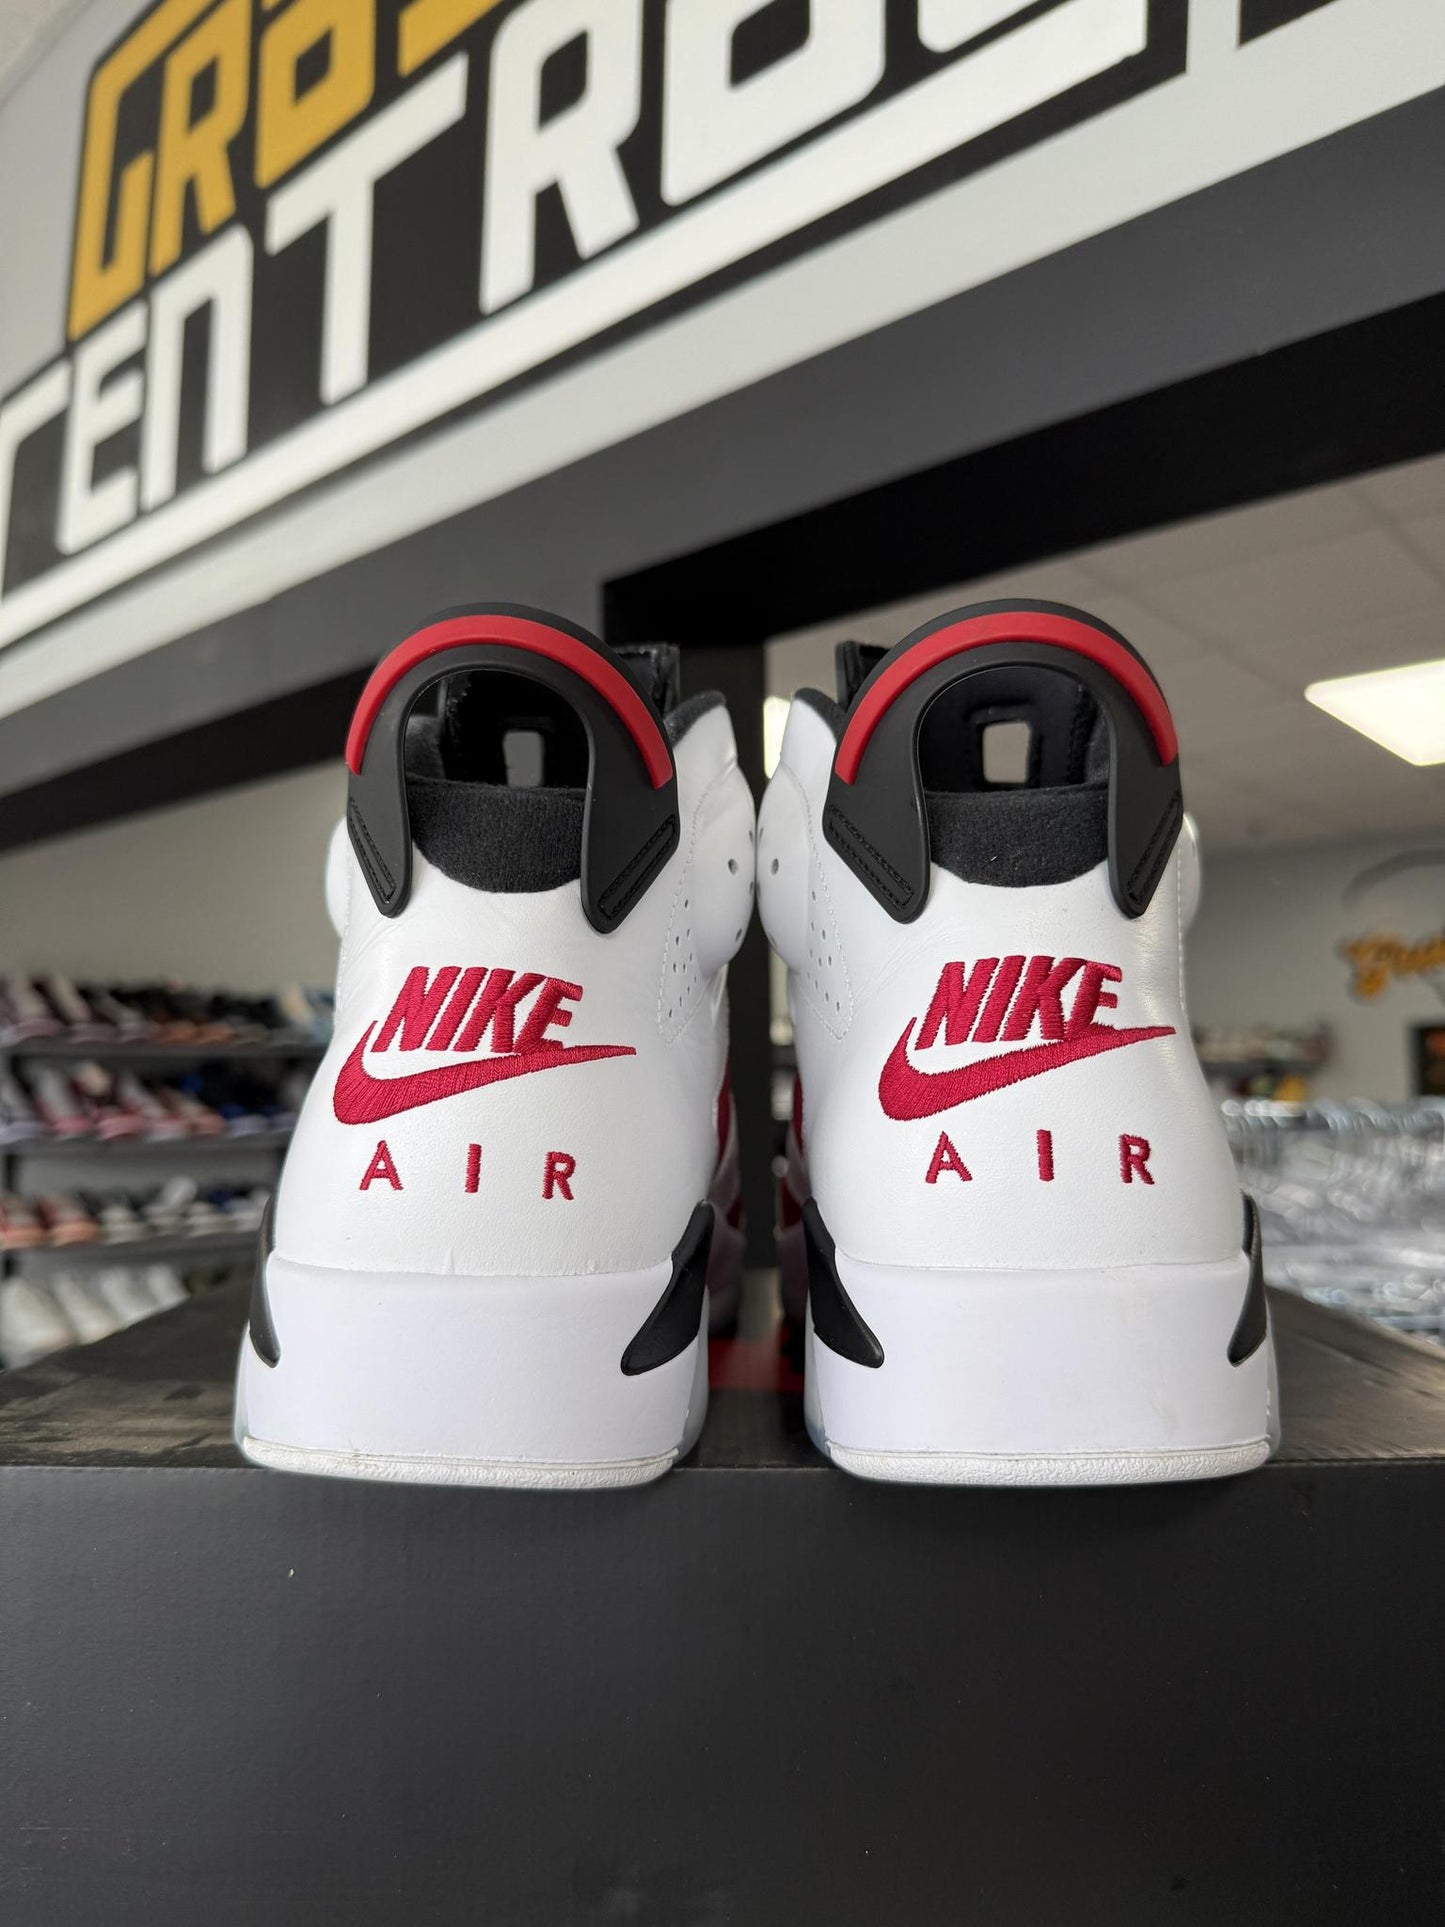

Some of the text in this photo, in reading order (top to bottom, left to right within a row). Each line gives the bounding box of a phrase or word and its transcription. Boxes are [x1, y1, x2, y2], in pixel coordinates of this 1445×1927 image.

[371, 965, 584, 1053] NIKE
[914, 955, 1123, 1050] NIKE
[359, 1139, 576, 1201] AIR
[925, 1129, 1155, 1185] AIR
